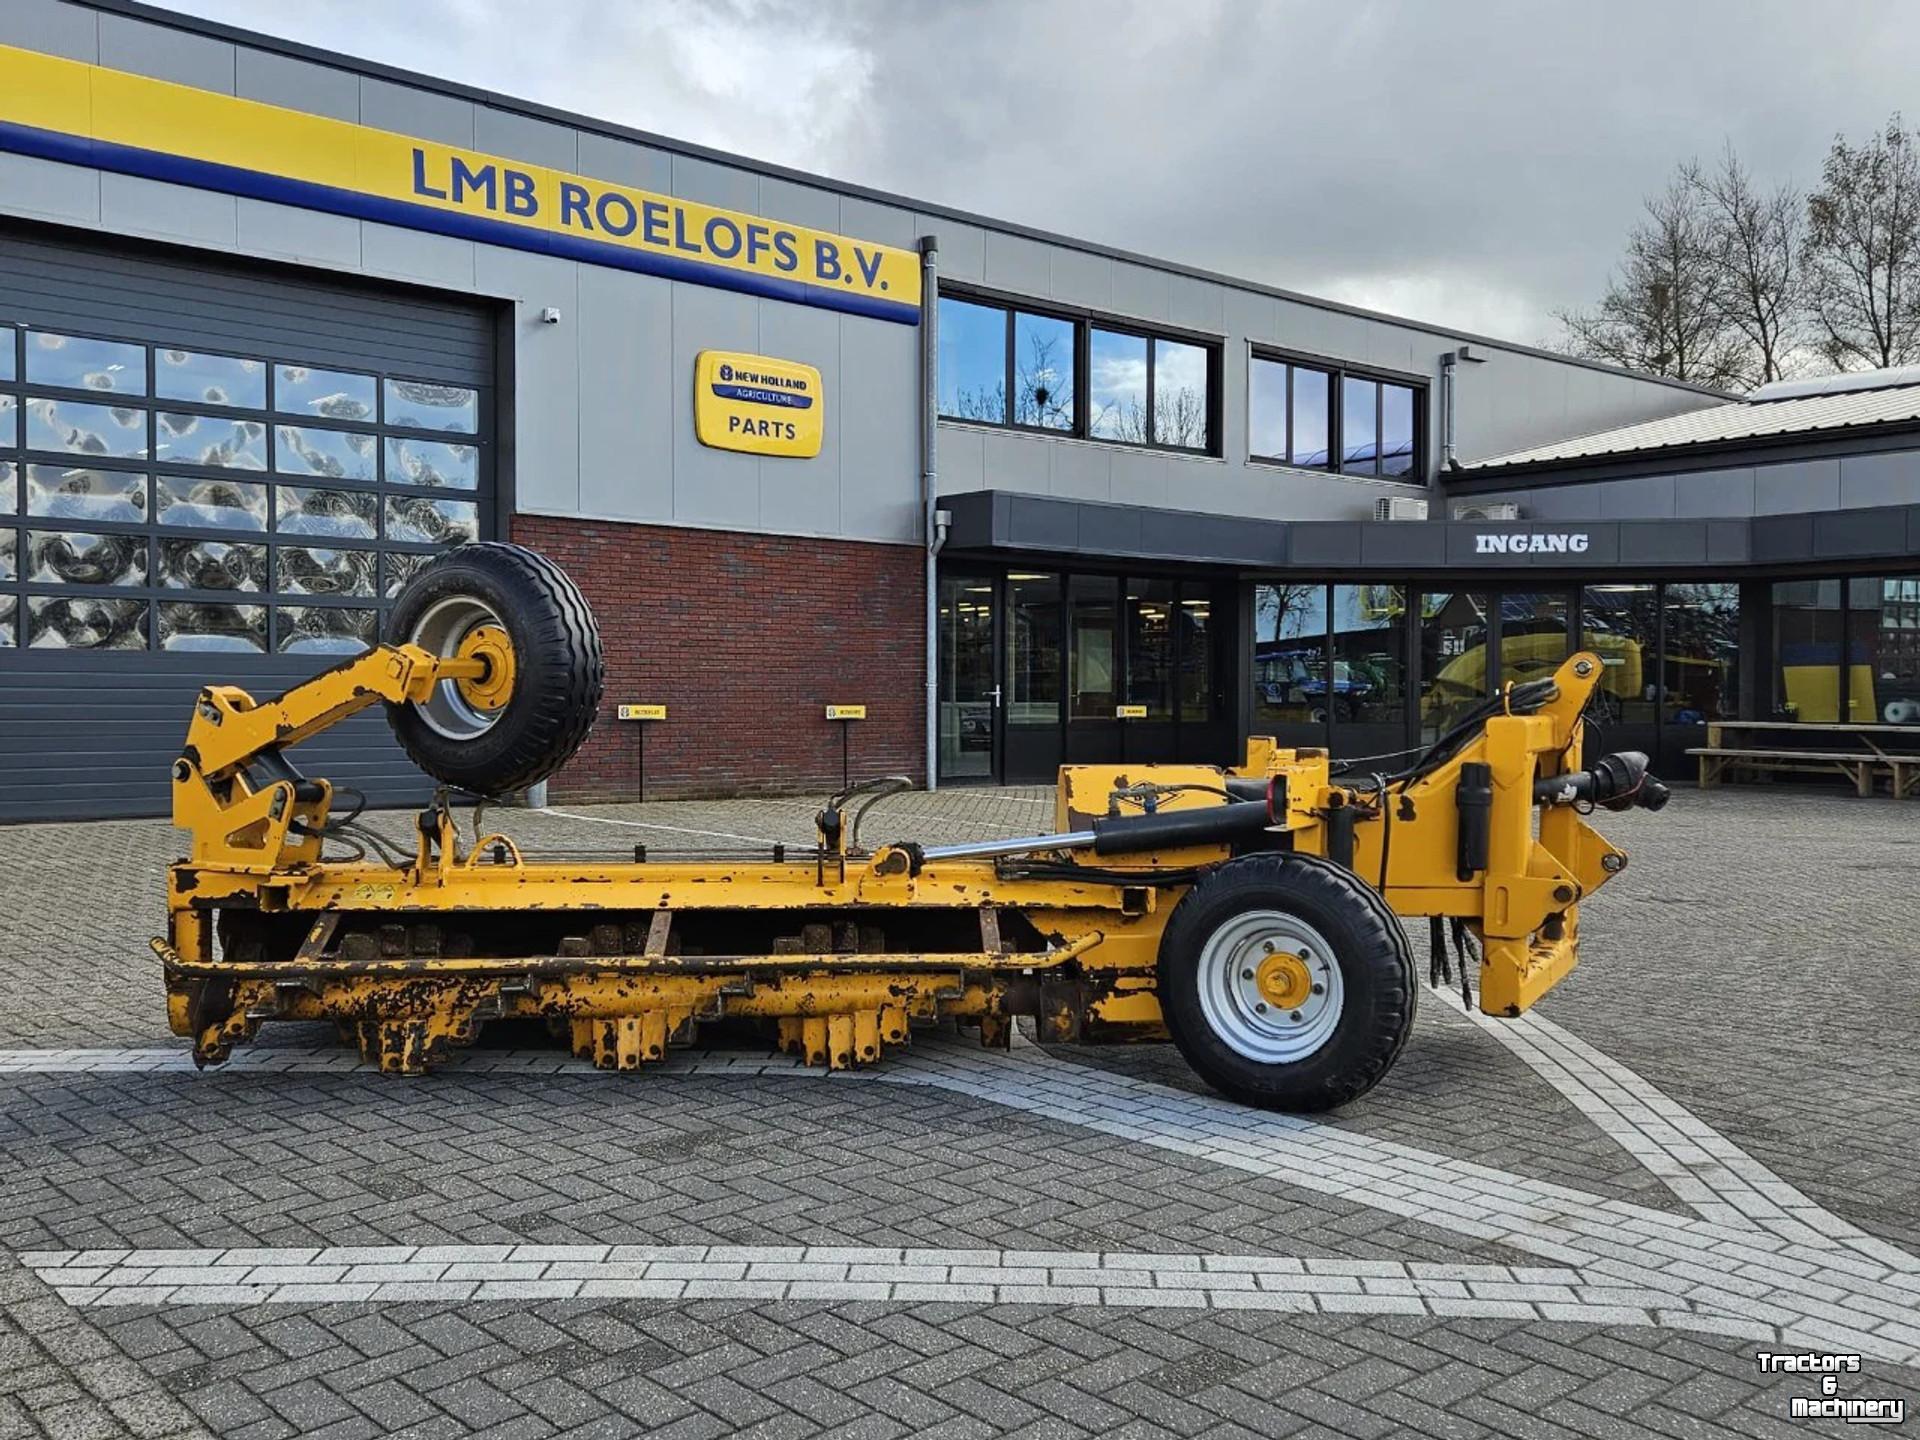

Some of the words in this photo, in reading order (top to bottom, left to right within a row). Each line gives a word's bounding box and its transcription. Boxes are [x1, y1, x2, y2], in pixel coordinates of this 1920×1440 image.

[412, 148, 539, 218] LMB
[560, 180, 798, 272] ROELOFS
[815, 239, 889, 291] B.V.
[735, 370, 759, 384] NEW
[761, 375, 807, 391] HOLLAND
[736, 388, 792, 405] AGRICULTURE
[729, 415, 796, 440] PARTS
[1476, 534, 1589, 553] INGANG
